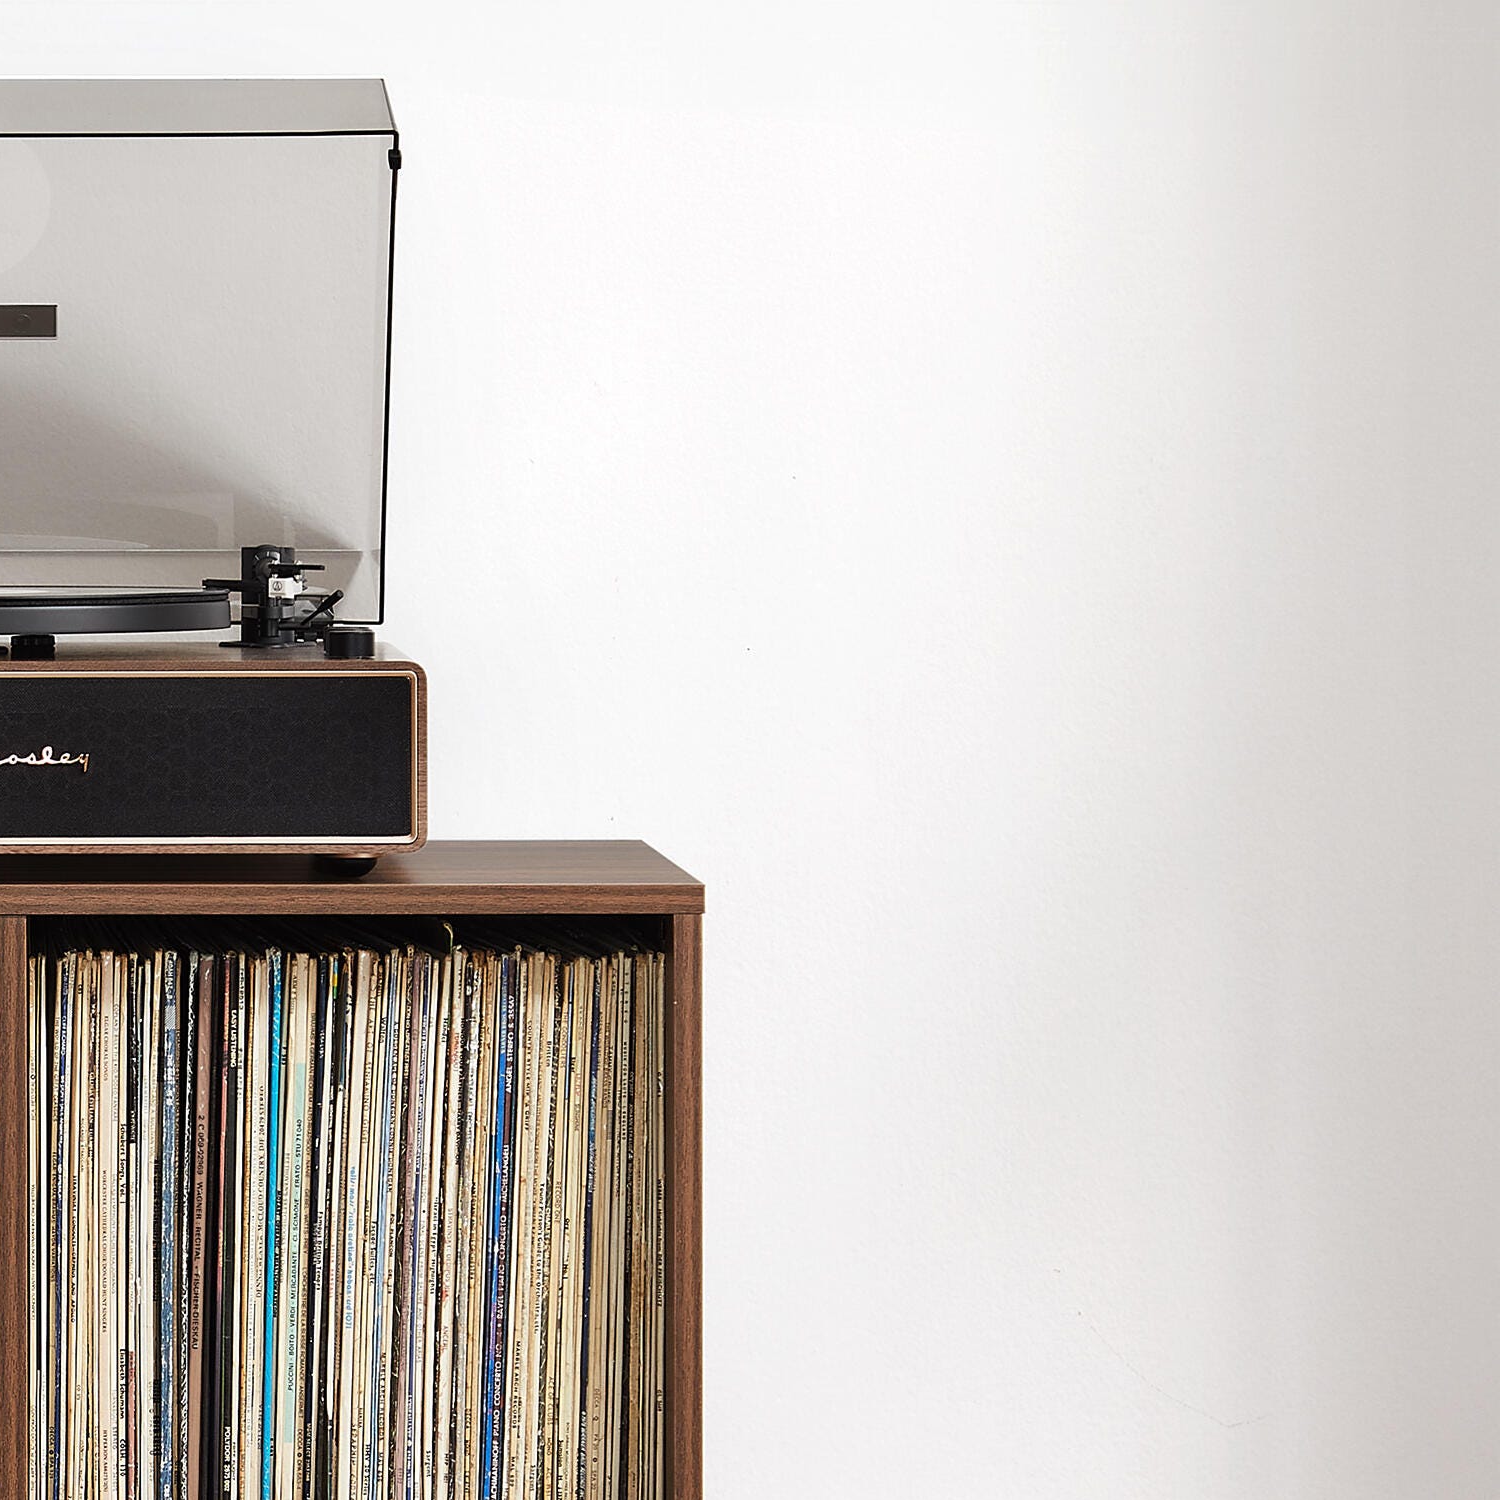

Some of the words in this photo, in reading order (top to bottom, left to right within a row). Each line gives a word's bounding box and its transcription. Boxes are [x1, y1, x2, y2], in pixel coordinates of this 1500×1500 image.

[195, 1182, 203, 1220] WAGNER
[538, 1183, 546, 1205] Young
[292, 1198, 300, 1231] SCIMONE
[537, 1204, 545, 1235] Person's
[194, 1226, 202, 1261] RECITAL
[494, 1361, 502, 1406] CONCERTO
[501, 1144, 509, 1202] MICHELANGELI
[505, 1066, 513, 1093] ANGEL
[290, 1251, 298, 1300] MERCADANTE
[191, 1273, 201, 1350] FISCHER-DIESKAU
